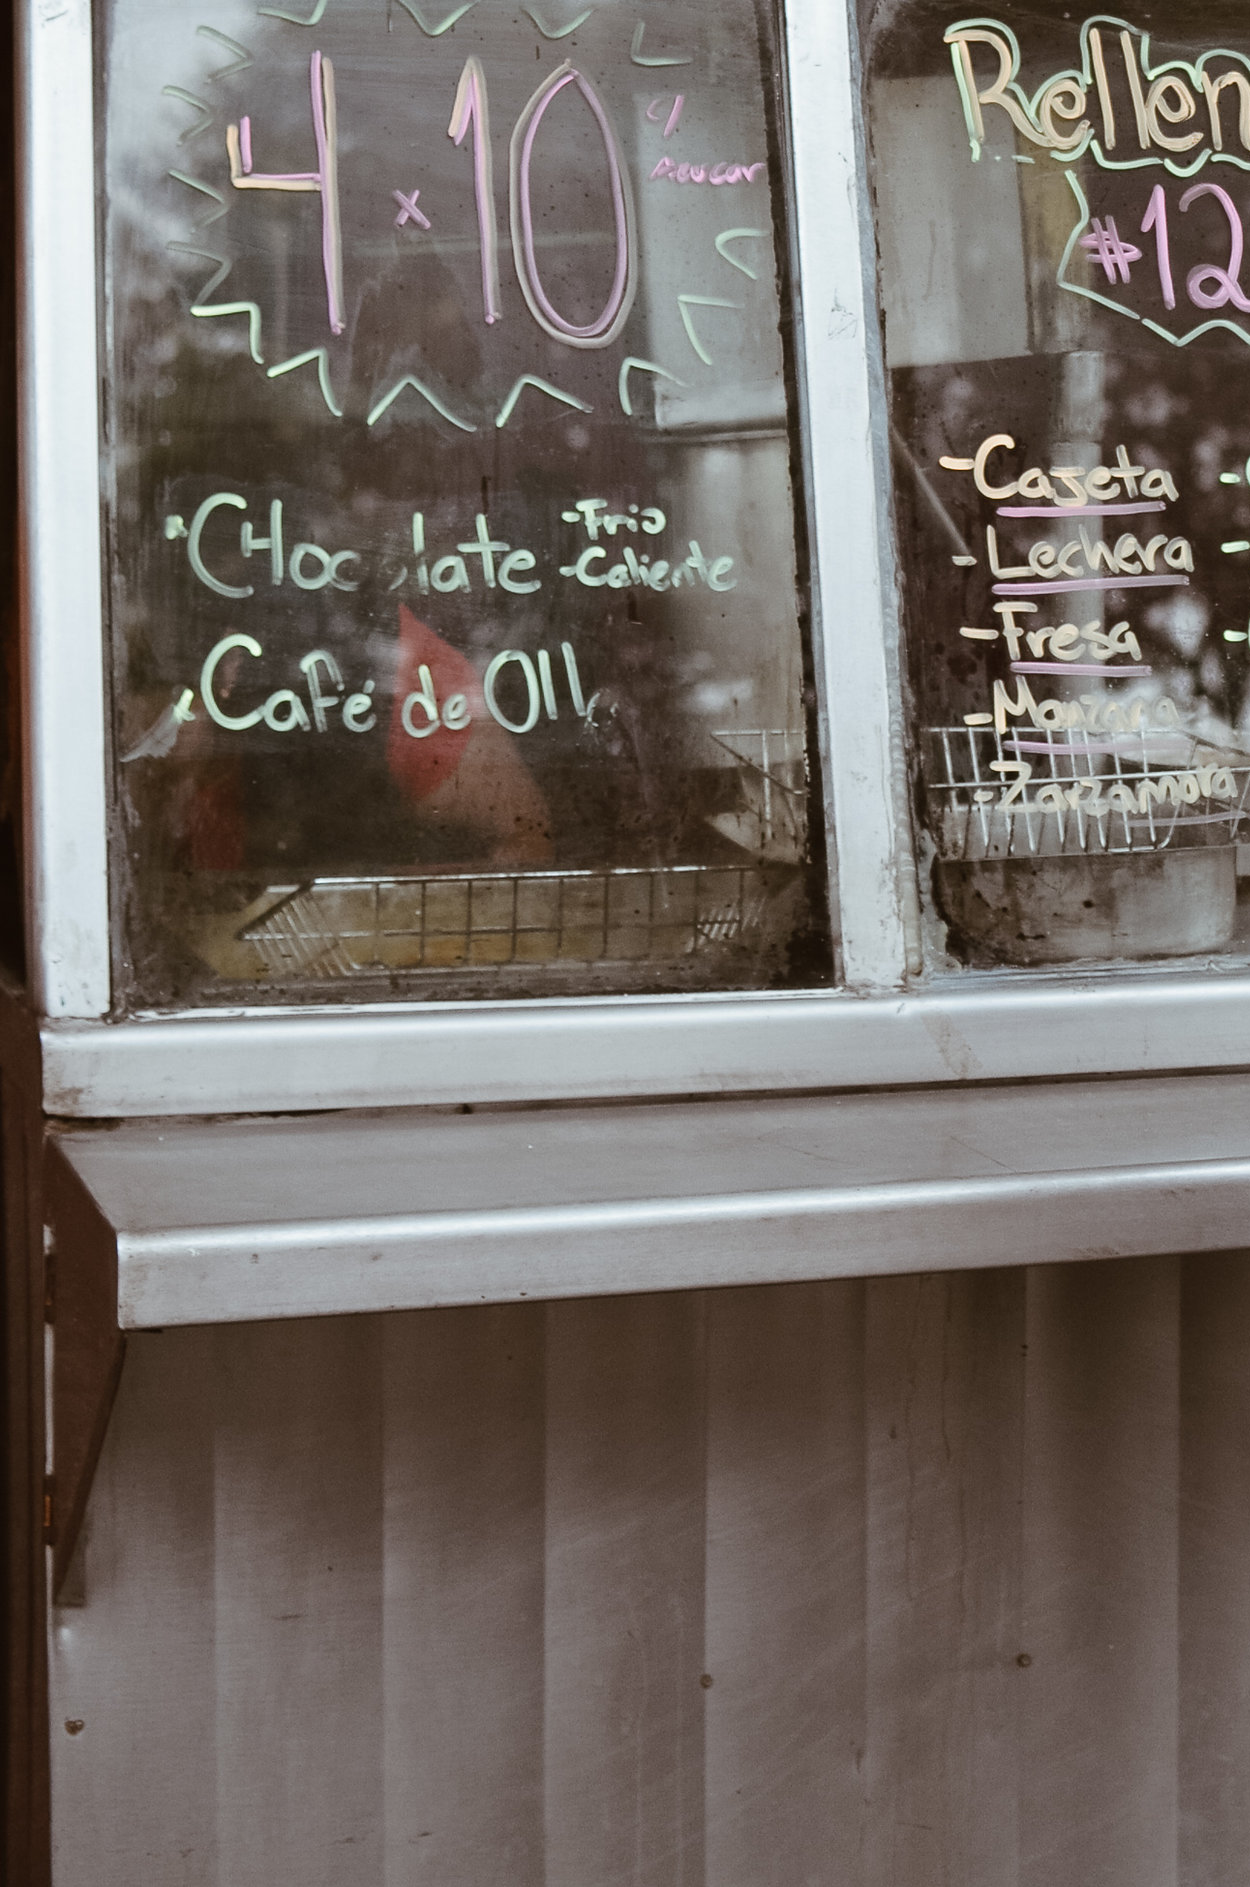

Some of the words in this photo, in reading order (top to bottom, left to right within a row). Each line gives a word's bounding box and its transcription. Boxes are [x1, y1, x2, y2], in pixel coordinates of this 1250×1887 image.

[227, 50, 345, 335] 4
[448, 55, 637, 348] 10
[402, 664, 472, 739] de
